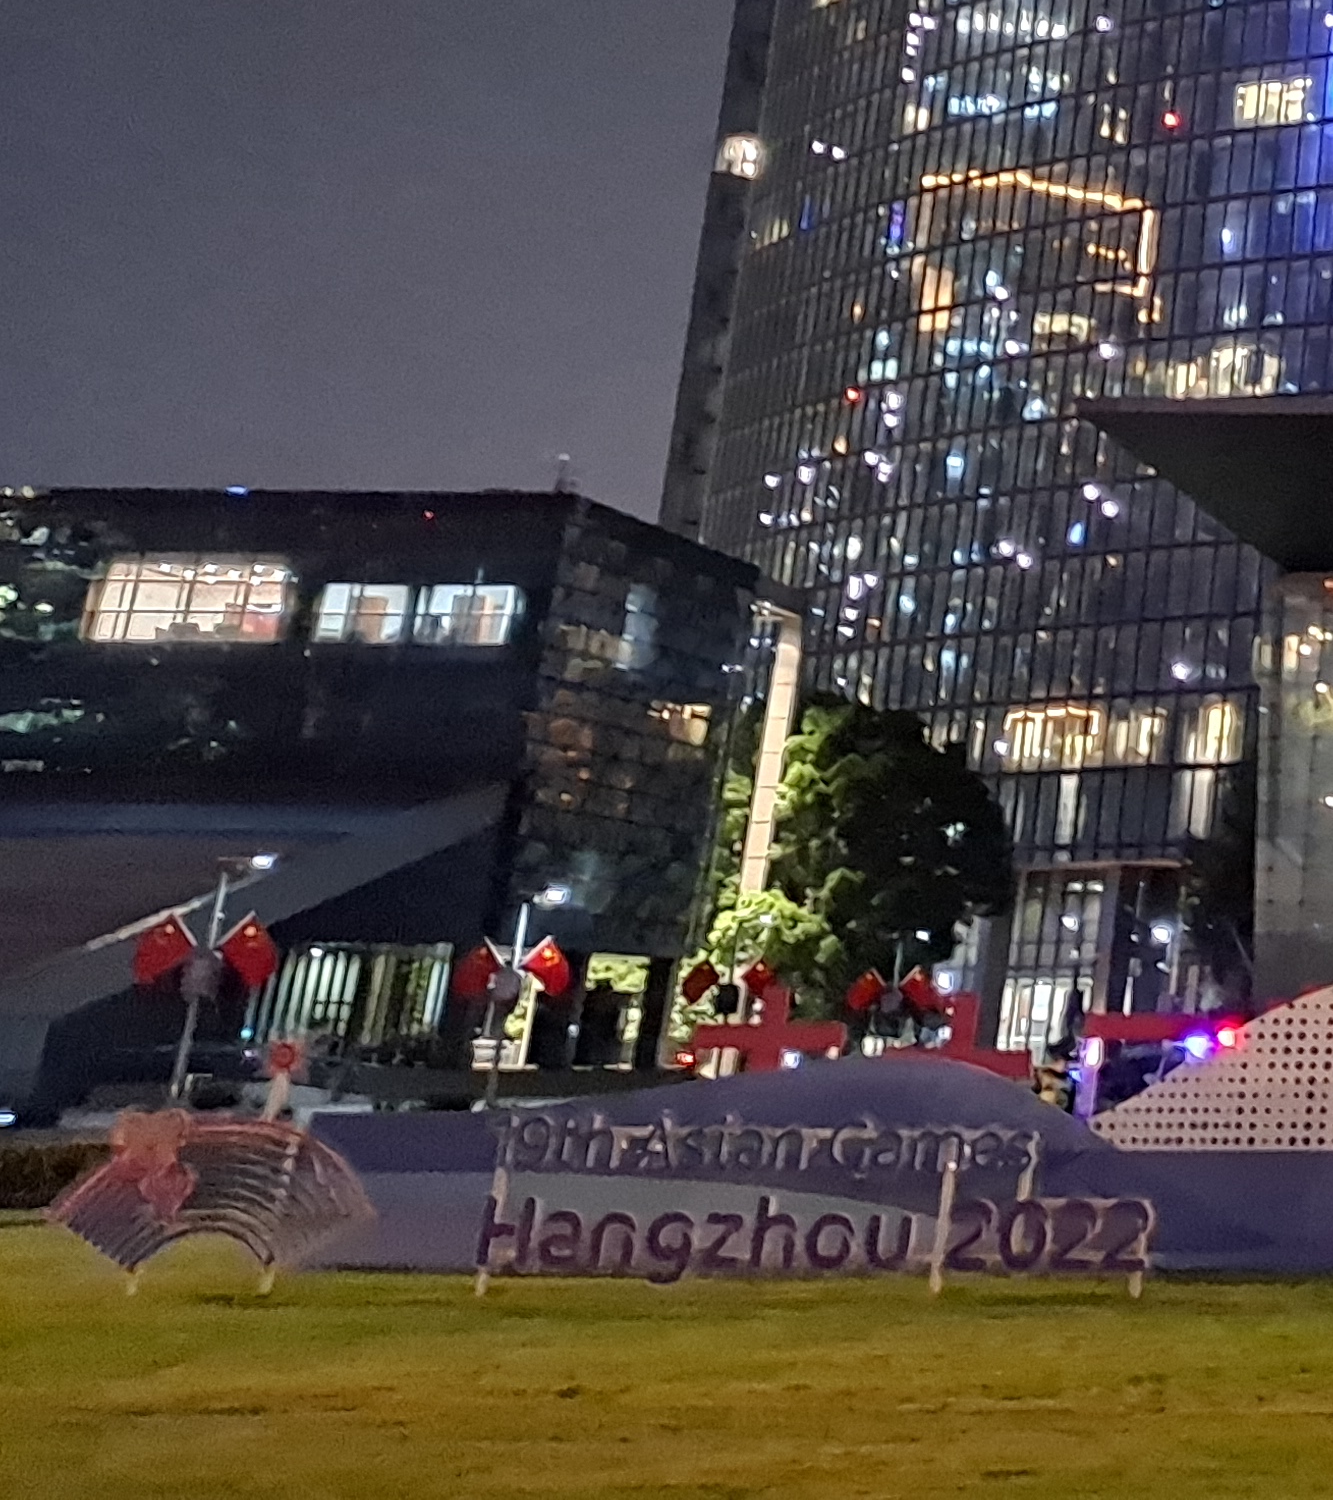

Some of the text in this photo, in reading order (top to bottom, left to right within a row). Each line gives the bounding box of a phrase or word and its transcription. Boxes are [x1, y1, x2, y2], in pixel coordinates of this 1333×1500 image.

[830, 1118, 1036, 1178] Games
[475, 1195, 1152, 1285] Hangzhou 2022
